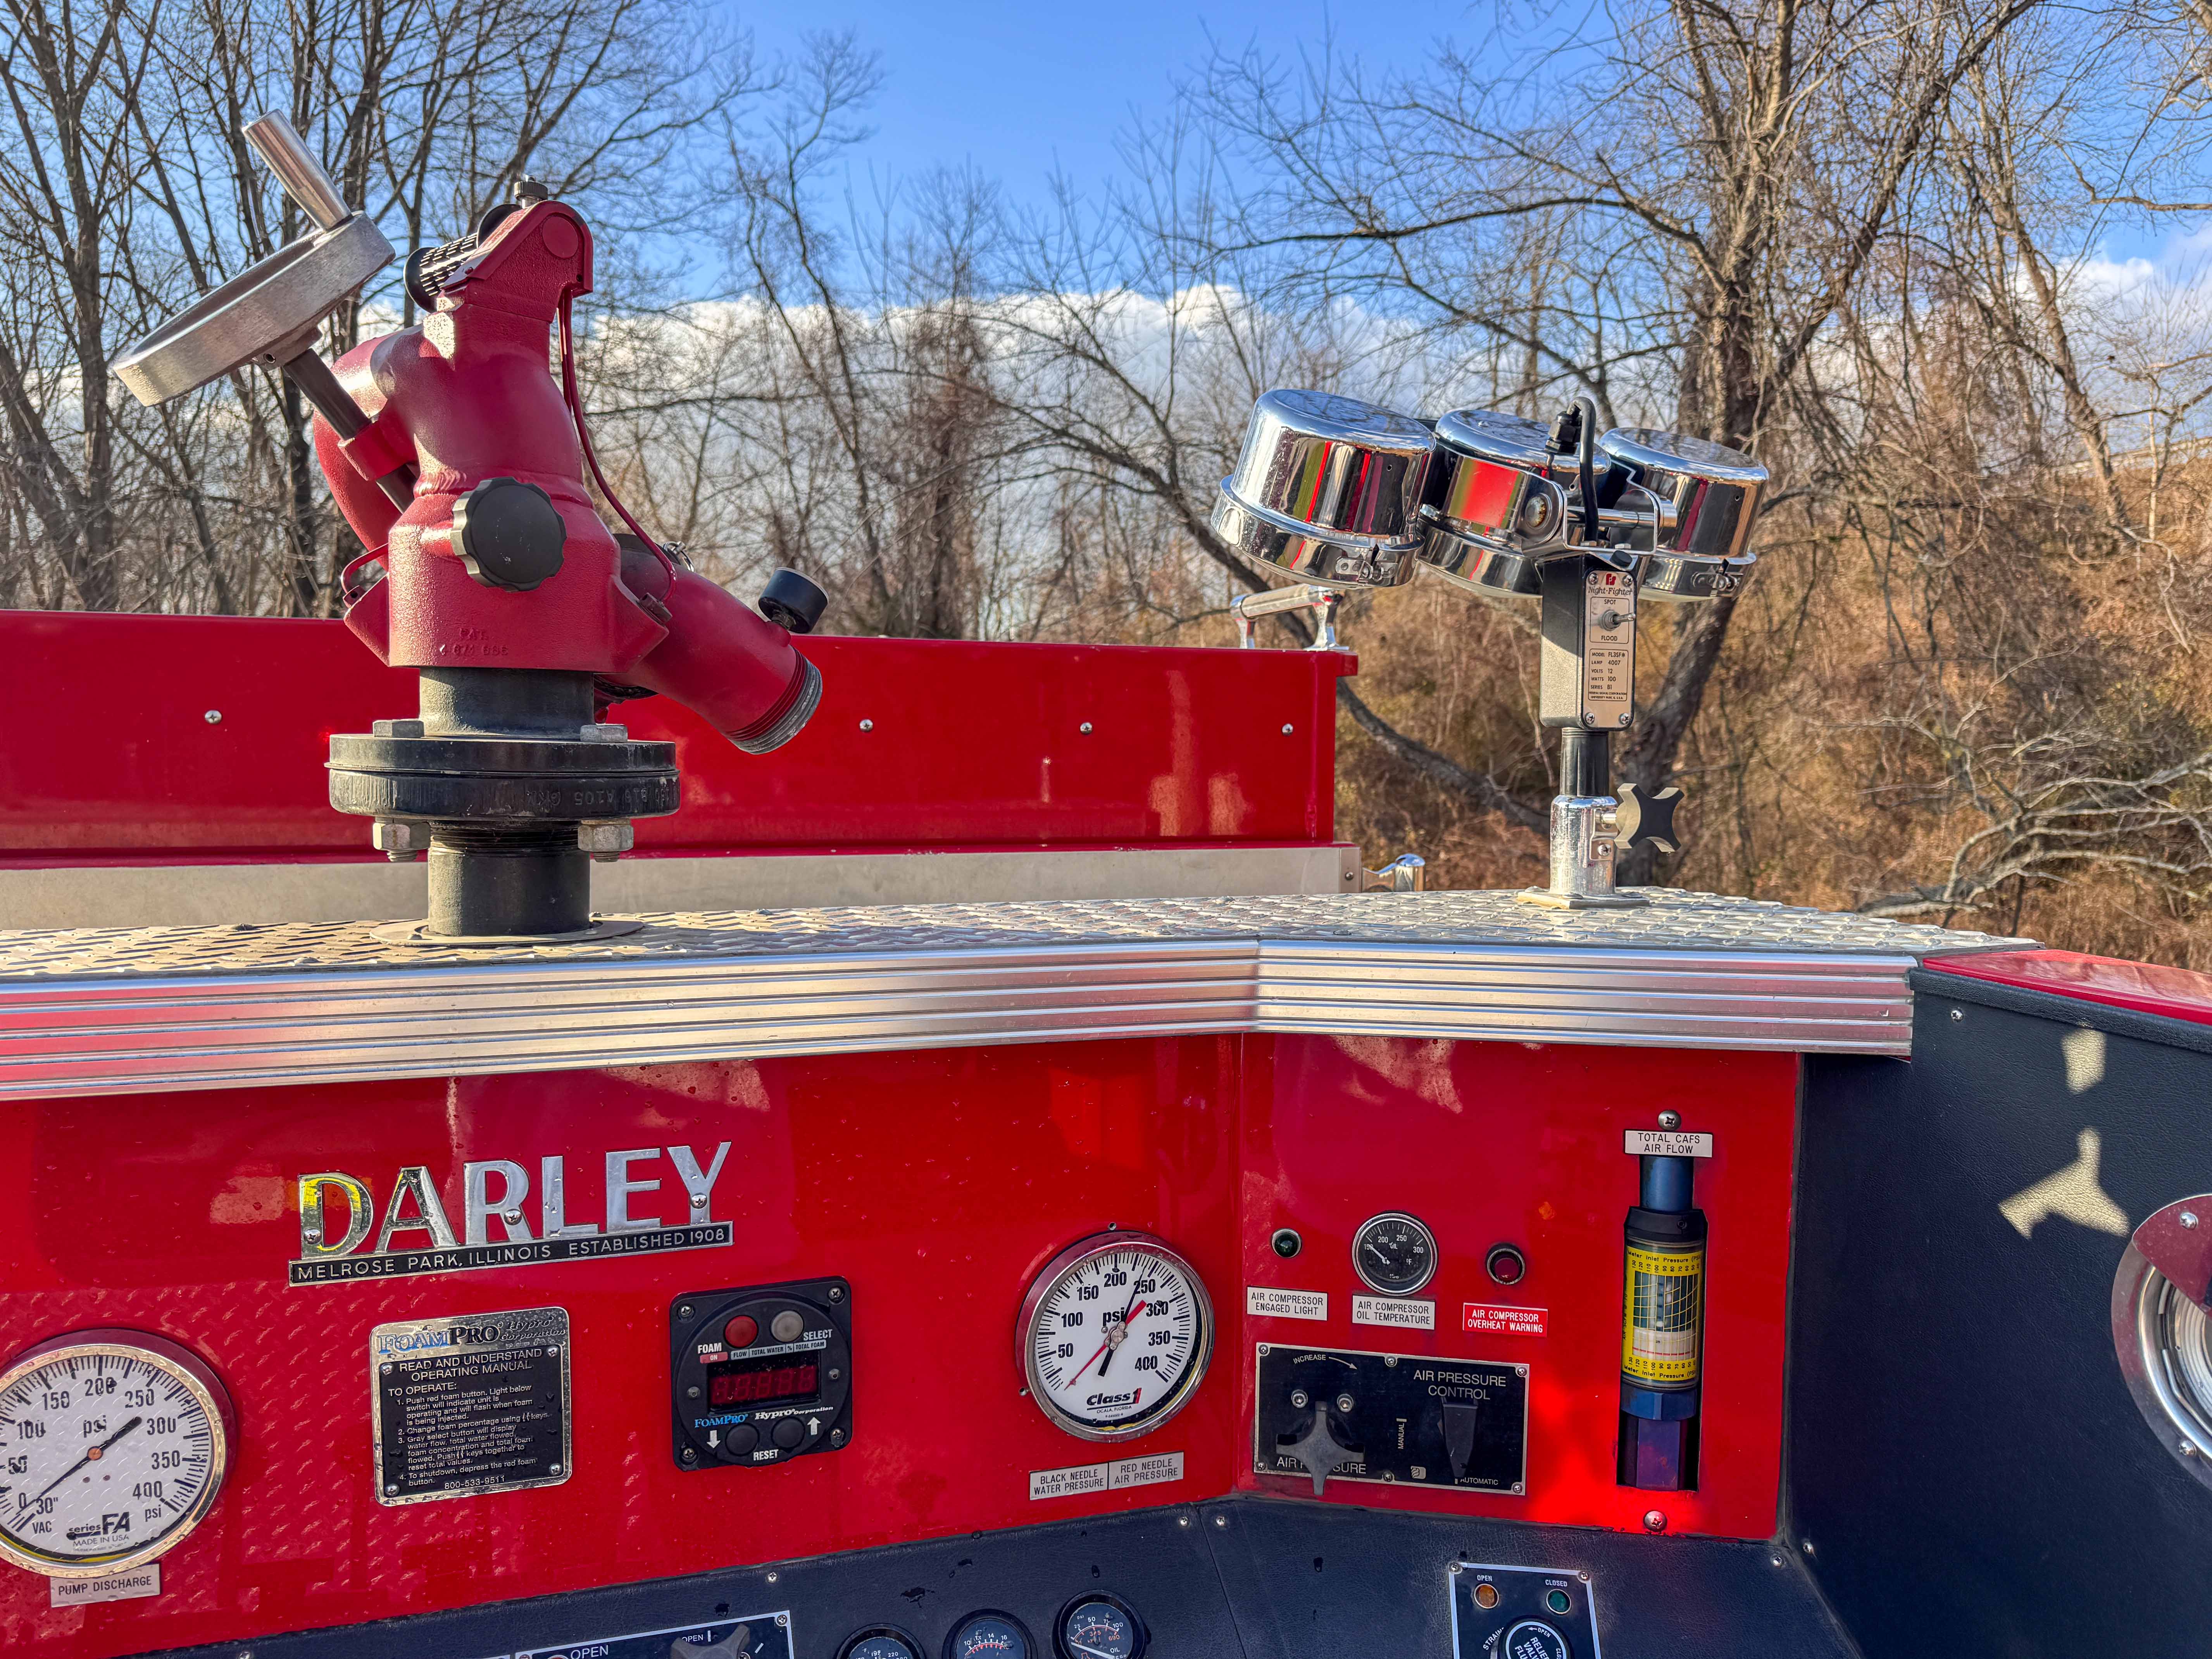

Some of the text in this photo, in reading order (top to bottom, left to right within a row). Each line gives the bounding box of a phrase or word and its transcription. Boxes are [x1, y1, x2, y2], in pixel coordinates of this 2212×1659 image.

[1588, 586, 1633, 595] Night-Fighter
[1638, 1133, 1700, 1143] TOTAL CAFS
[1644, 1144, 1693, 1154] AIR FLOW
[298, 1142, 732, 1260] DARLEY
[298, 1229, 724, 1280] MELROSE PARK, ILLINOIS ESTABLISHED 1908
[1103, 1272, 1155, 1294] 200 250
[1077, 1286, 1168, 1317] 150 300
[1252, 1292, 1323, 1305] AIR COMPRESSOR
[1256, 1302, 1318, 1315] ENGAGED LIGHT
[1359, 1302, 1429, 1314] AIR COMPRESSOR
[1357, 1311, 1430, 1324] OIL TEMPERATURE
[1472, 1309, 1538, 1322] AIR COMPRESSOR
[1061, 1307, 1171, 1345] 100 psi 350
[1468, 1319, 1543, 1333] OVERHEAT WARNING
[803, 1330, 833, 1341] SELECT
[698, 1343, 722, 1354] FOAM
[400, 1349, 542, 1372] READ AND UNDERSTAND
[1058, 1343, 1158, 1371] 50 400
[1293, 1354, 1326, 1364] INCREASE
[411, 1360, 533, 1381] OPERATING MANUAL
[1414, 1370, 1506, 1387] AIR PRESSURE
[85, 1378, 116, 1395] 200
[388, 1382, 457, 1397] TO OPERATE:
[1428, 1385, 1490, 1400] CONTROL
[42, 1389, 154, 1409] 150 250
[407, 1410, 441, 1419] operating
[17, 1417, 176, 1439] 100 300
[459, 1419, 499, 1429] percentage
[429, 1443, 479, 1454] concentration
[485, 1446, 516, 1454] together
[753, 1449, 778, 1461] RESET
[152, 1451, 180, 1469] 350
[1121, 1459, 1172, 1473] RED NEEDLE
[1277, 1457, 1297, 1468] AIR
[460, 1464, 488, 1473] depress
[445, 1475, 505, 1490] 800-533-9511
[1040, 1469, 1098, 1484] BLACK NEEDLE
[1115, 1468, 1178, 1484] AIR PRESSURE
[1034, 1478, 1103, 1495] WATER PRESSURE
[19, 1481, 162, 1509] 0 400
[33, 1505, 162, 1534] VAC psi
[69, 1512, 130, 1535] series FA
[73, 1538, 97, 1547] MADE
[59, 1576, 152, 1595] PUMP DISCHARGE
[1538, 1628, 1551, 1637] OPEN
[571, 1645, 608, 1659] OPEN
